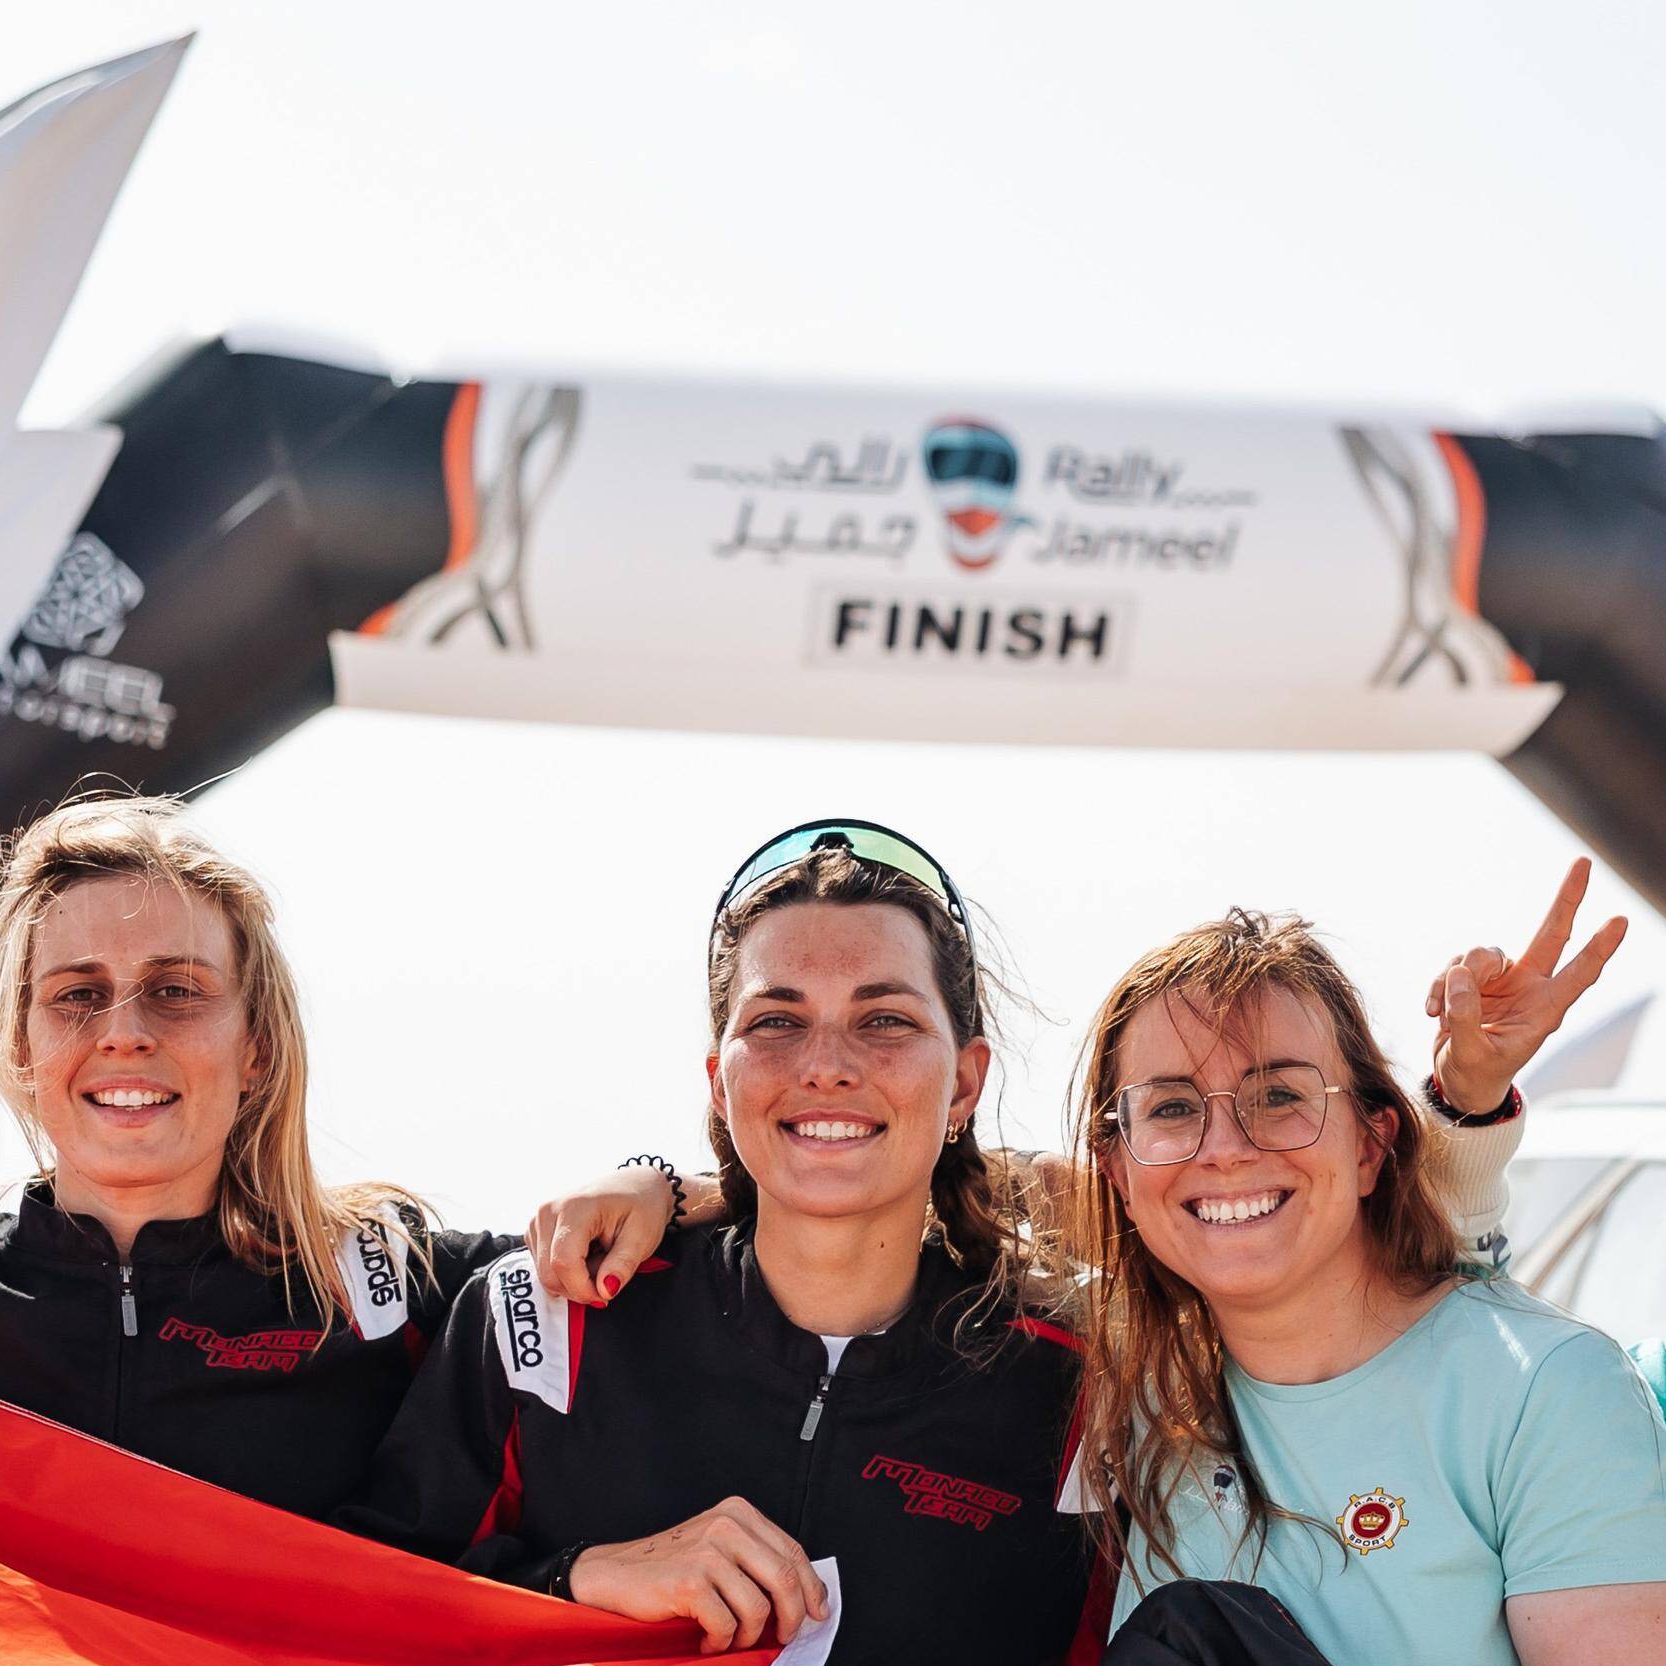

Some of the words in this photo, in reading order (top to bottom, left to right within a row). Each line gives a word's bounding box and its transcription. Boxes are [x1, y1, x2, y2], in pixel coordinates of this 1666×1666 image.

[1043, 444, 1186, 504] Rally
[1030, 518, 1241, 568] Jameel
[832, 599, 1112, 661] FINISH
[505, 1268, 544, 1368] sparco
[1348, 1533, 1387, 1548] SPORT
